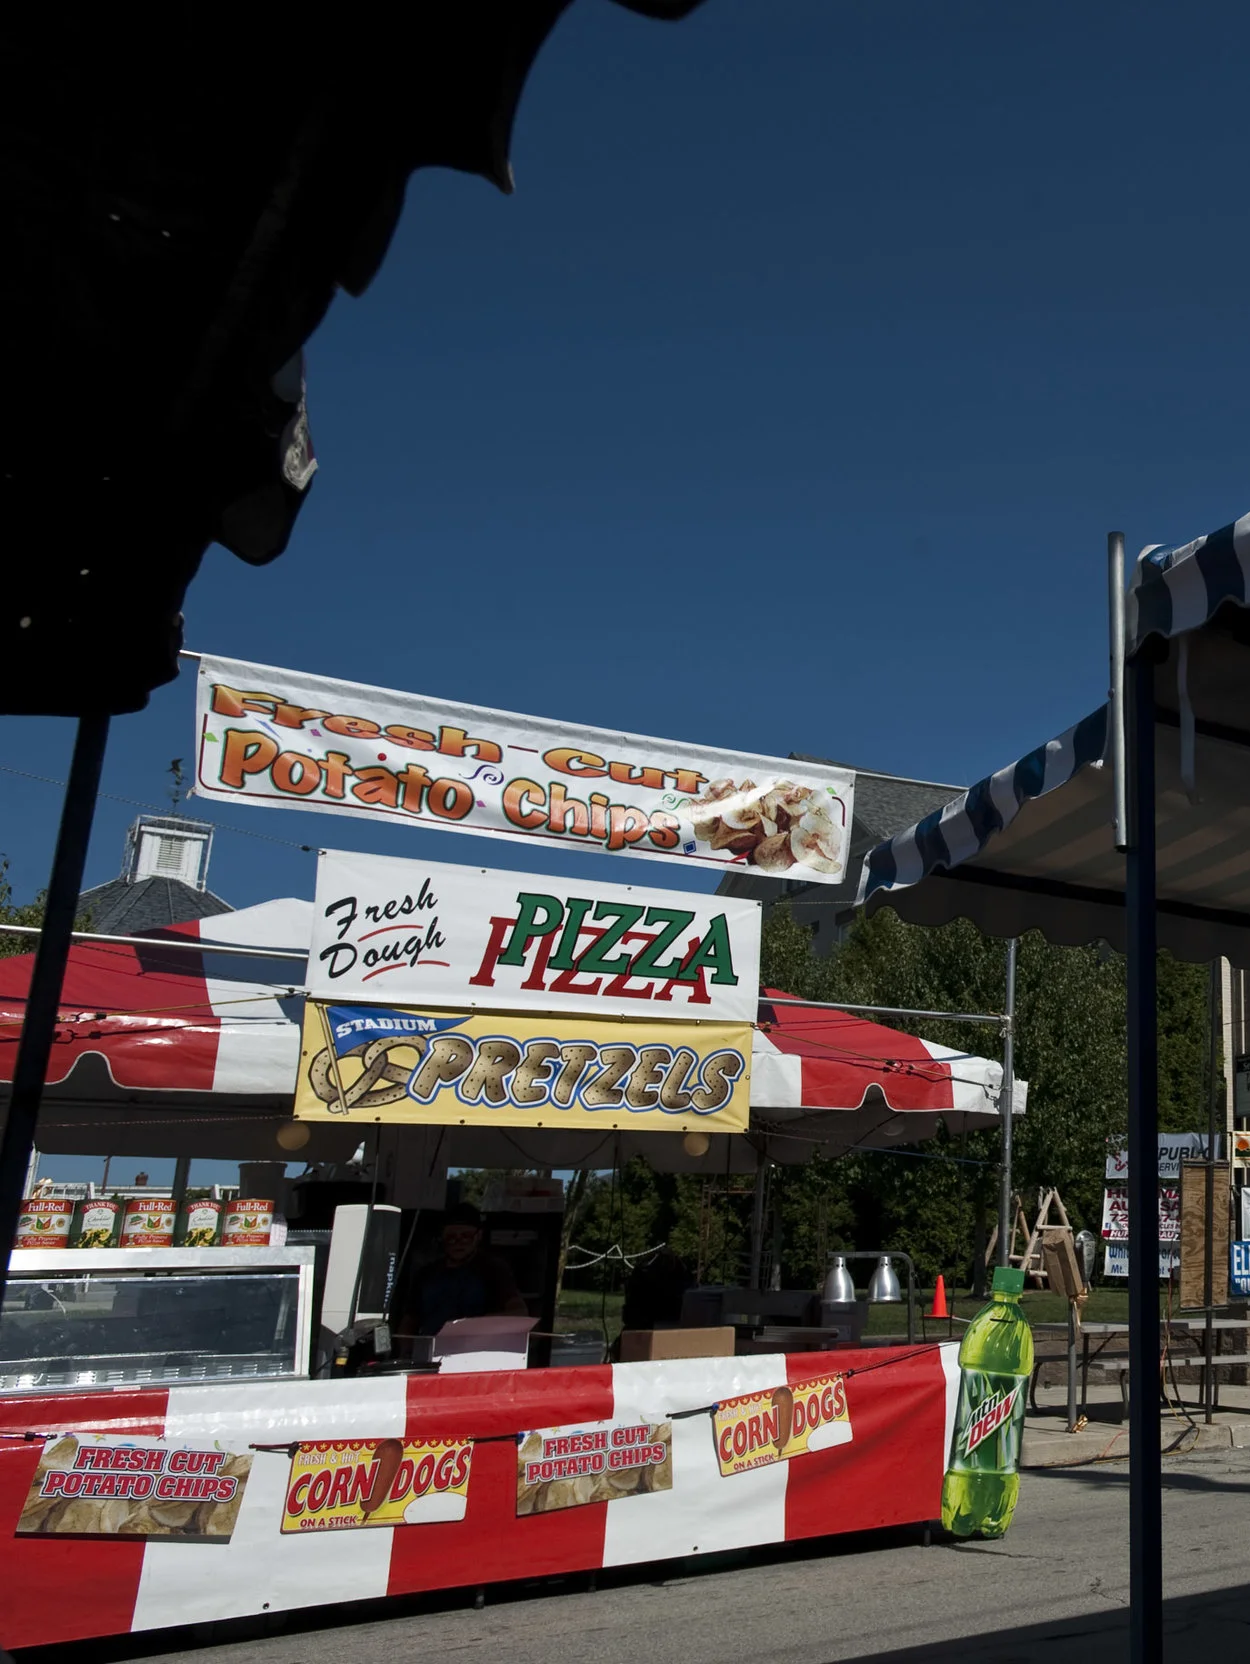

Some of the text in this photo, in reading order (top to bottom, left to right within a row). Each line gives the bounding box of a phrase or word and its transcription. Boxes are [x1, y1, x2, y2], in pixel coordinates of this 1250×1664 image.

[219, 728, 680, 851] Potato Chips
[326, 878, 438, 936] Fresh
[320, 916, 445, 979] Dough
[475, 892, 738, 1000] PIZZA
[335, 1017, 436, 1039] STADIUM
[408, 1033, 745, 1114] PRETZELS
[28, 1202, 65, 1212] Full-Red
[138, 1202, 173, 1211] Full-Red
[236, 1202, 268, 1211] Full-Red
[719, 1381, 846, 1463] CORN DOGS
[298, 1452, 361, 1465] FRESH & HOT
[543, 1423, 651, 1460] FRESH CUT
[75, 1445, 226, 1475] FRESH CUT
[525, 1441, 668, 1487] POTATO CHIPS
[734, 1453, 775, 1471] ON A STICK
[42, 1471, 239, 1502] POTATO CHIPS
[287, 1445, 472, 1517] CORN DOGS
[300, 1515, 357, 1528] ON A STICK
